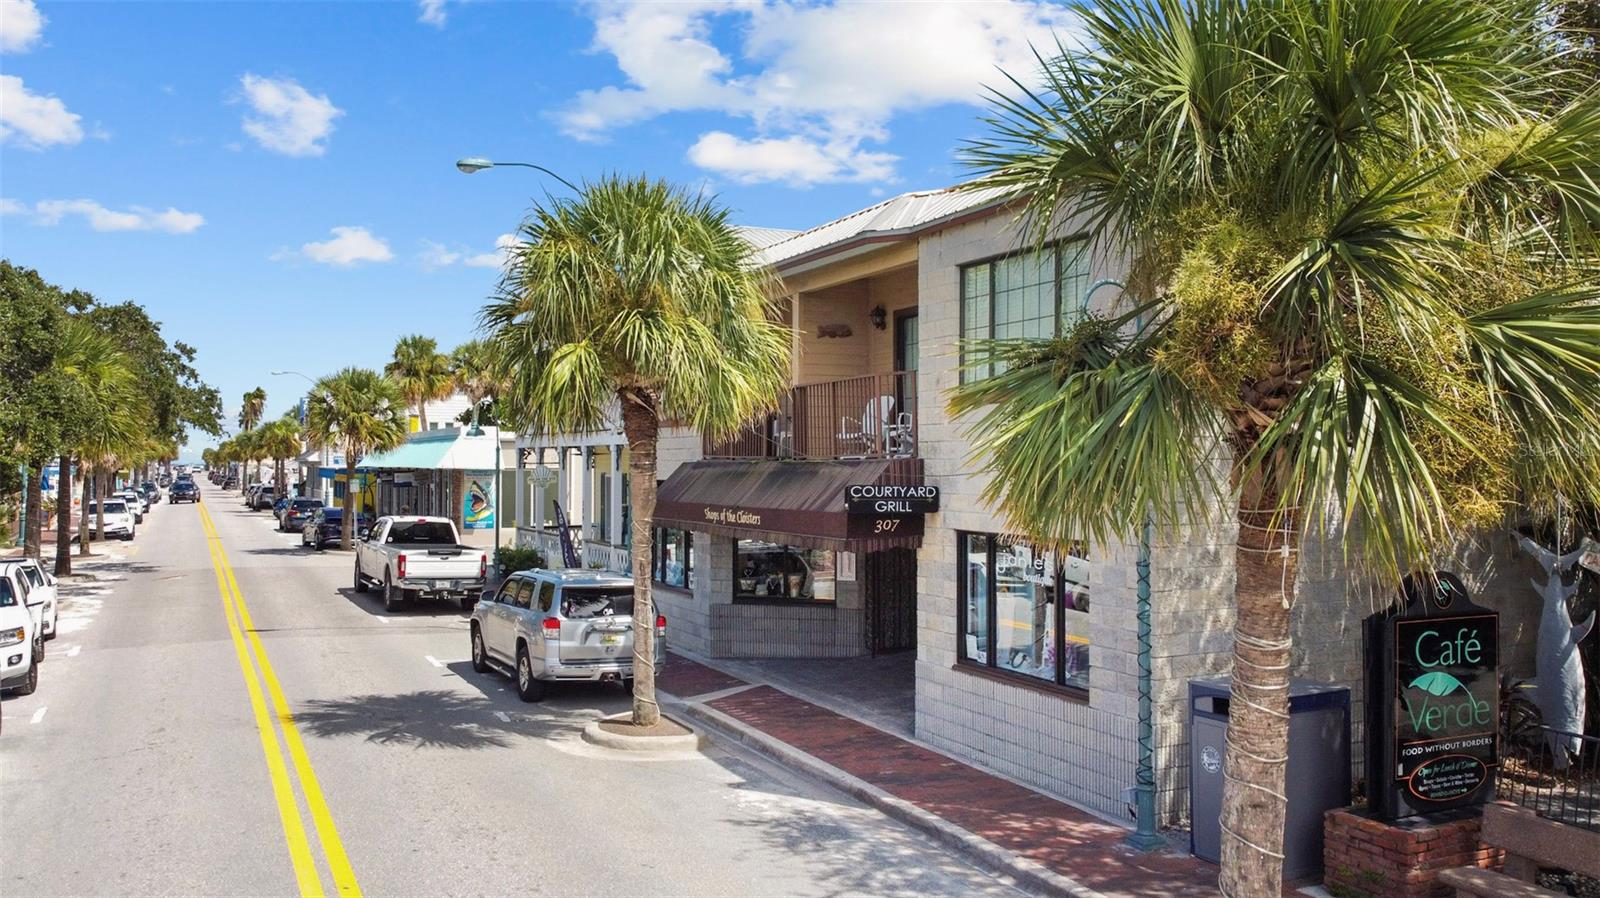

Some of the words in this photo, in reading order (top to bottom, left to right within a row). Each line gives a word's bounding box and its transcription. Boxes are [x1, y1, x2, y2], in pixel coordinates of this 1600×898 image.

[850, 485, 937, 498] COURTYARD
[875, 500, 913, 512] GRILL
[704, 507, 720, 524] Shops
[720, 508, 726, 525] of
[726, 509, 736, 523] the
[736, 510, 761, 525] Cloisters
[874, 519, 901, 533] 307
[1415, 628, 1481, 668] Café
[1401, 686, 1490, 733] Verde
[1402, 747, 1424, 757] FOOD
[1425, 741, 1461, 753] WITHOUT
[1462, 737, 1493, 748] BORDERS
